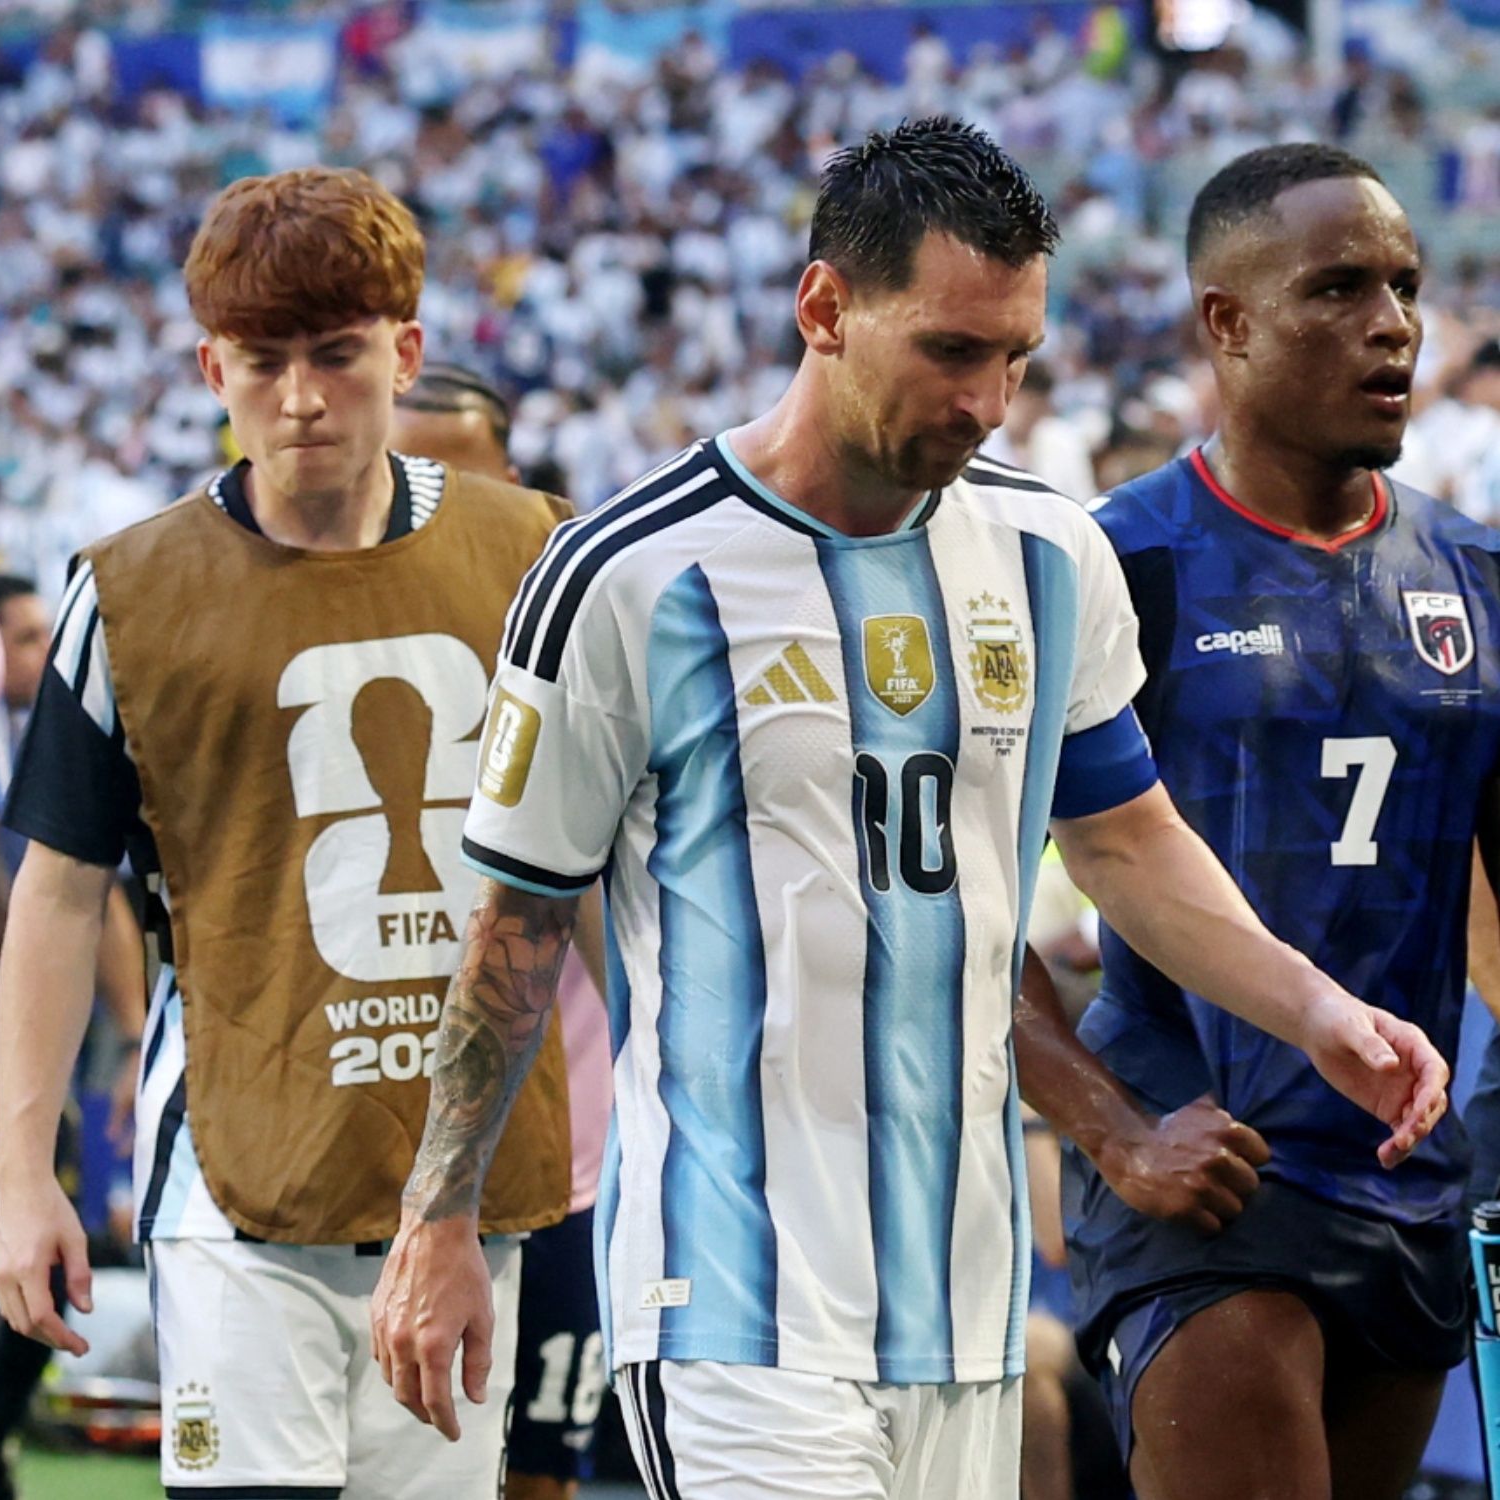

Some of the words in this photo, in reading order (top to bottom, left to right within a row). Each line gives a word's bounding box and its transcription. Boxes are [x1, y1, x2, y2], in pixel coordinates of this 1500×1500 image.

[1411, 596, 1457, 609] FCF
[1195, 624, 1283, 654] capelli
[1241, 645, 1283, 656] SPORT
[886, 677, 916, 691] FIFA
[1320, 736, 1398, 866] 7
[853, 751, 958, 895] 10
[377, 910, 458, 947] FIFA
[324, 993, 440, 1033] WORLD
